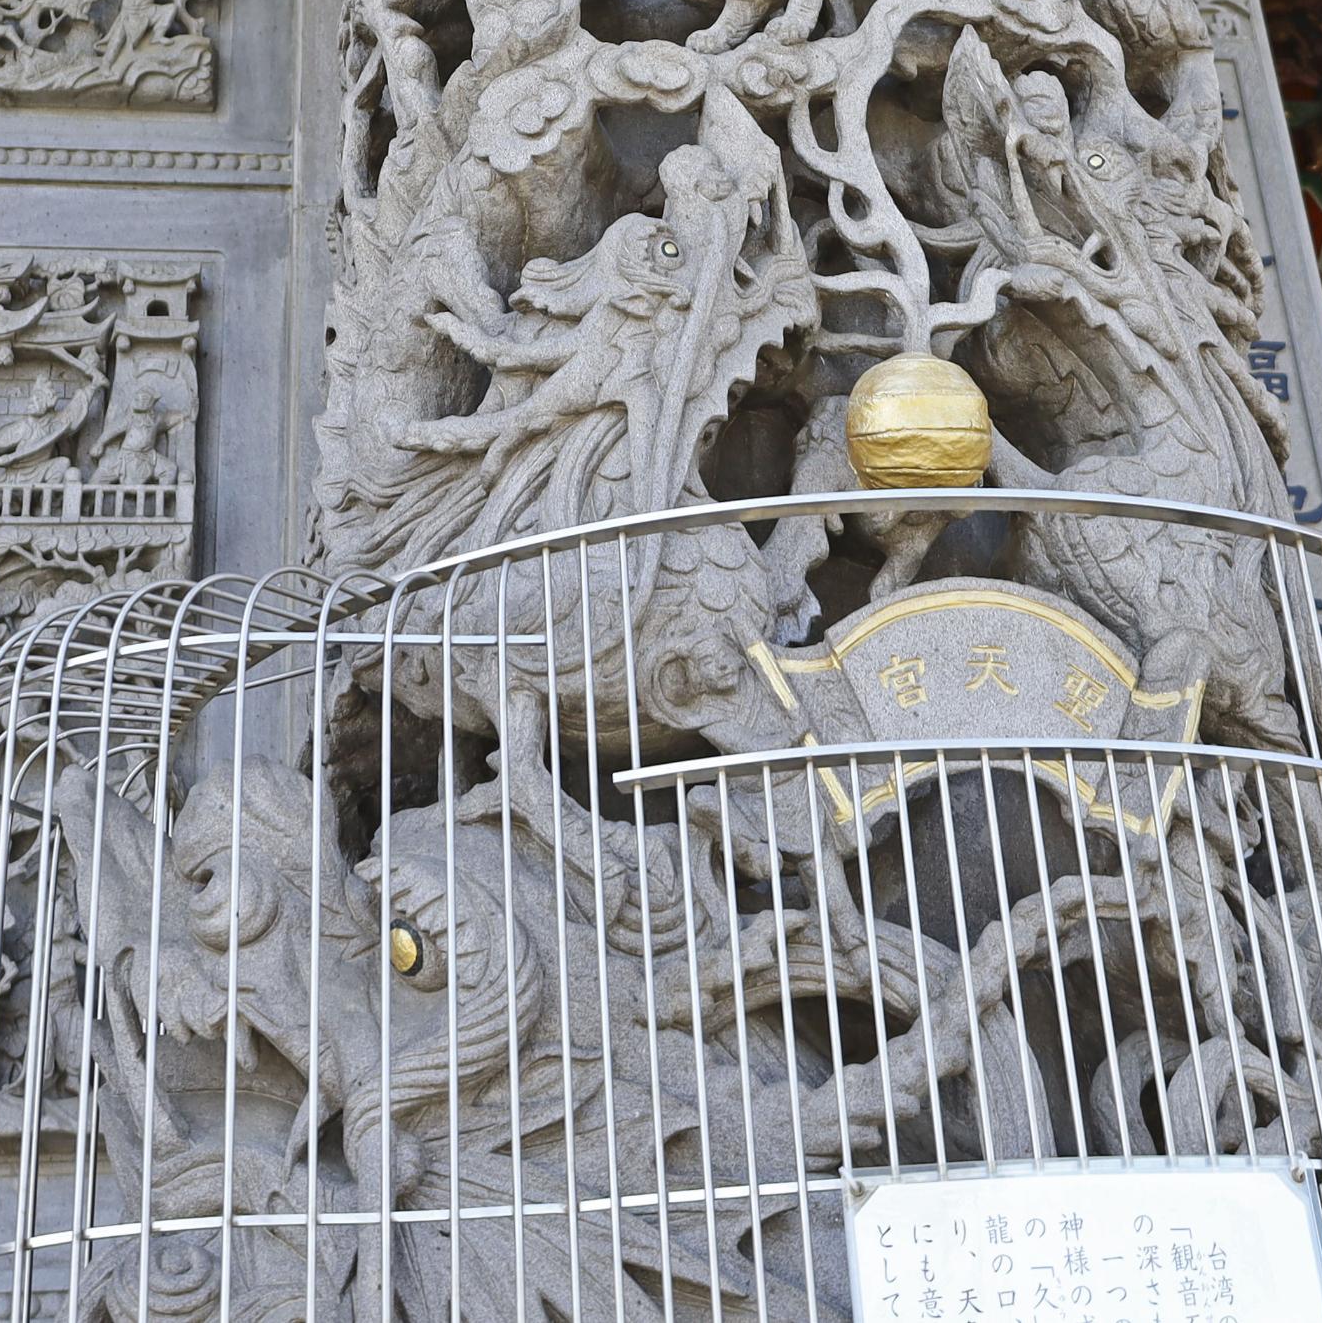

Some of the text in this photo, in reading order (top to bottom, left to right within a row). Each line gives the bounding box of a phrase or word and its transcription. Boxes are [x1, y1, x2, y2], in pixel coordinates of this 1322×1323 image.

[877, 1225, 900, 1318] として
[913, 1224, 944, 1319] にも意
[954, 1219, 984, 1323] り、天
[986, 1214, 1021, 1323] 龍の口
[1025, 1218, 1059, 1323] の「久
[1102, 1255, 1132, 1323] 一つ
[1133, 1214, 1162, 1323] の深さ
